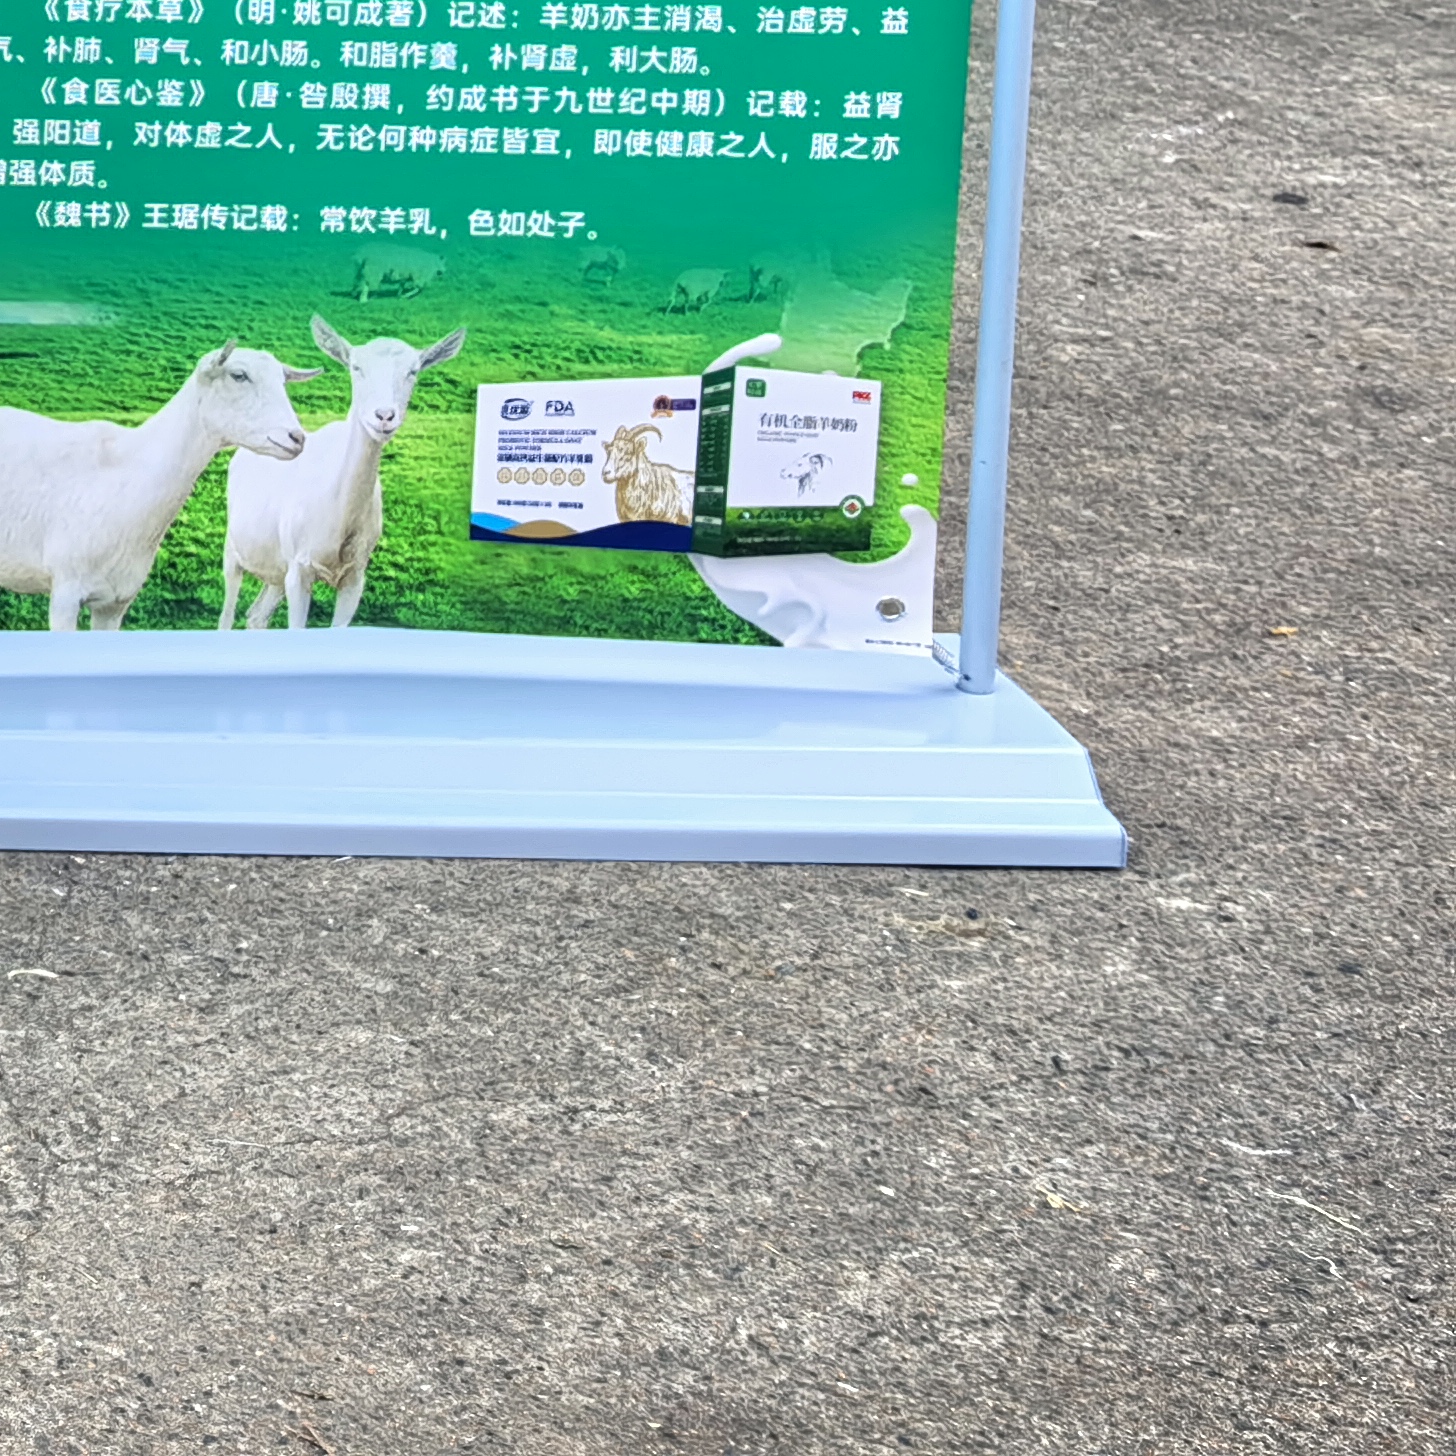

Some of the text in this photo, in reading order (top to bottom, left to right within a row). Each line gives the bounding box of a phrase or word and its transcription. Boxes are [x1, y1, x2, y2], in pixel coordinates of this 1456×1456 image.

[759, 412, 858, 433] 有机全脂羊奶粉
